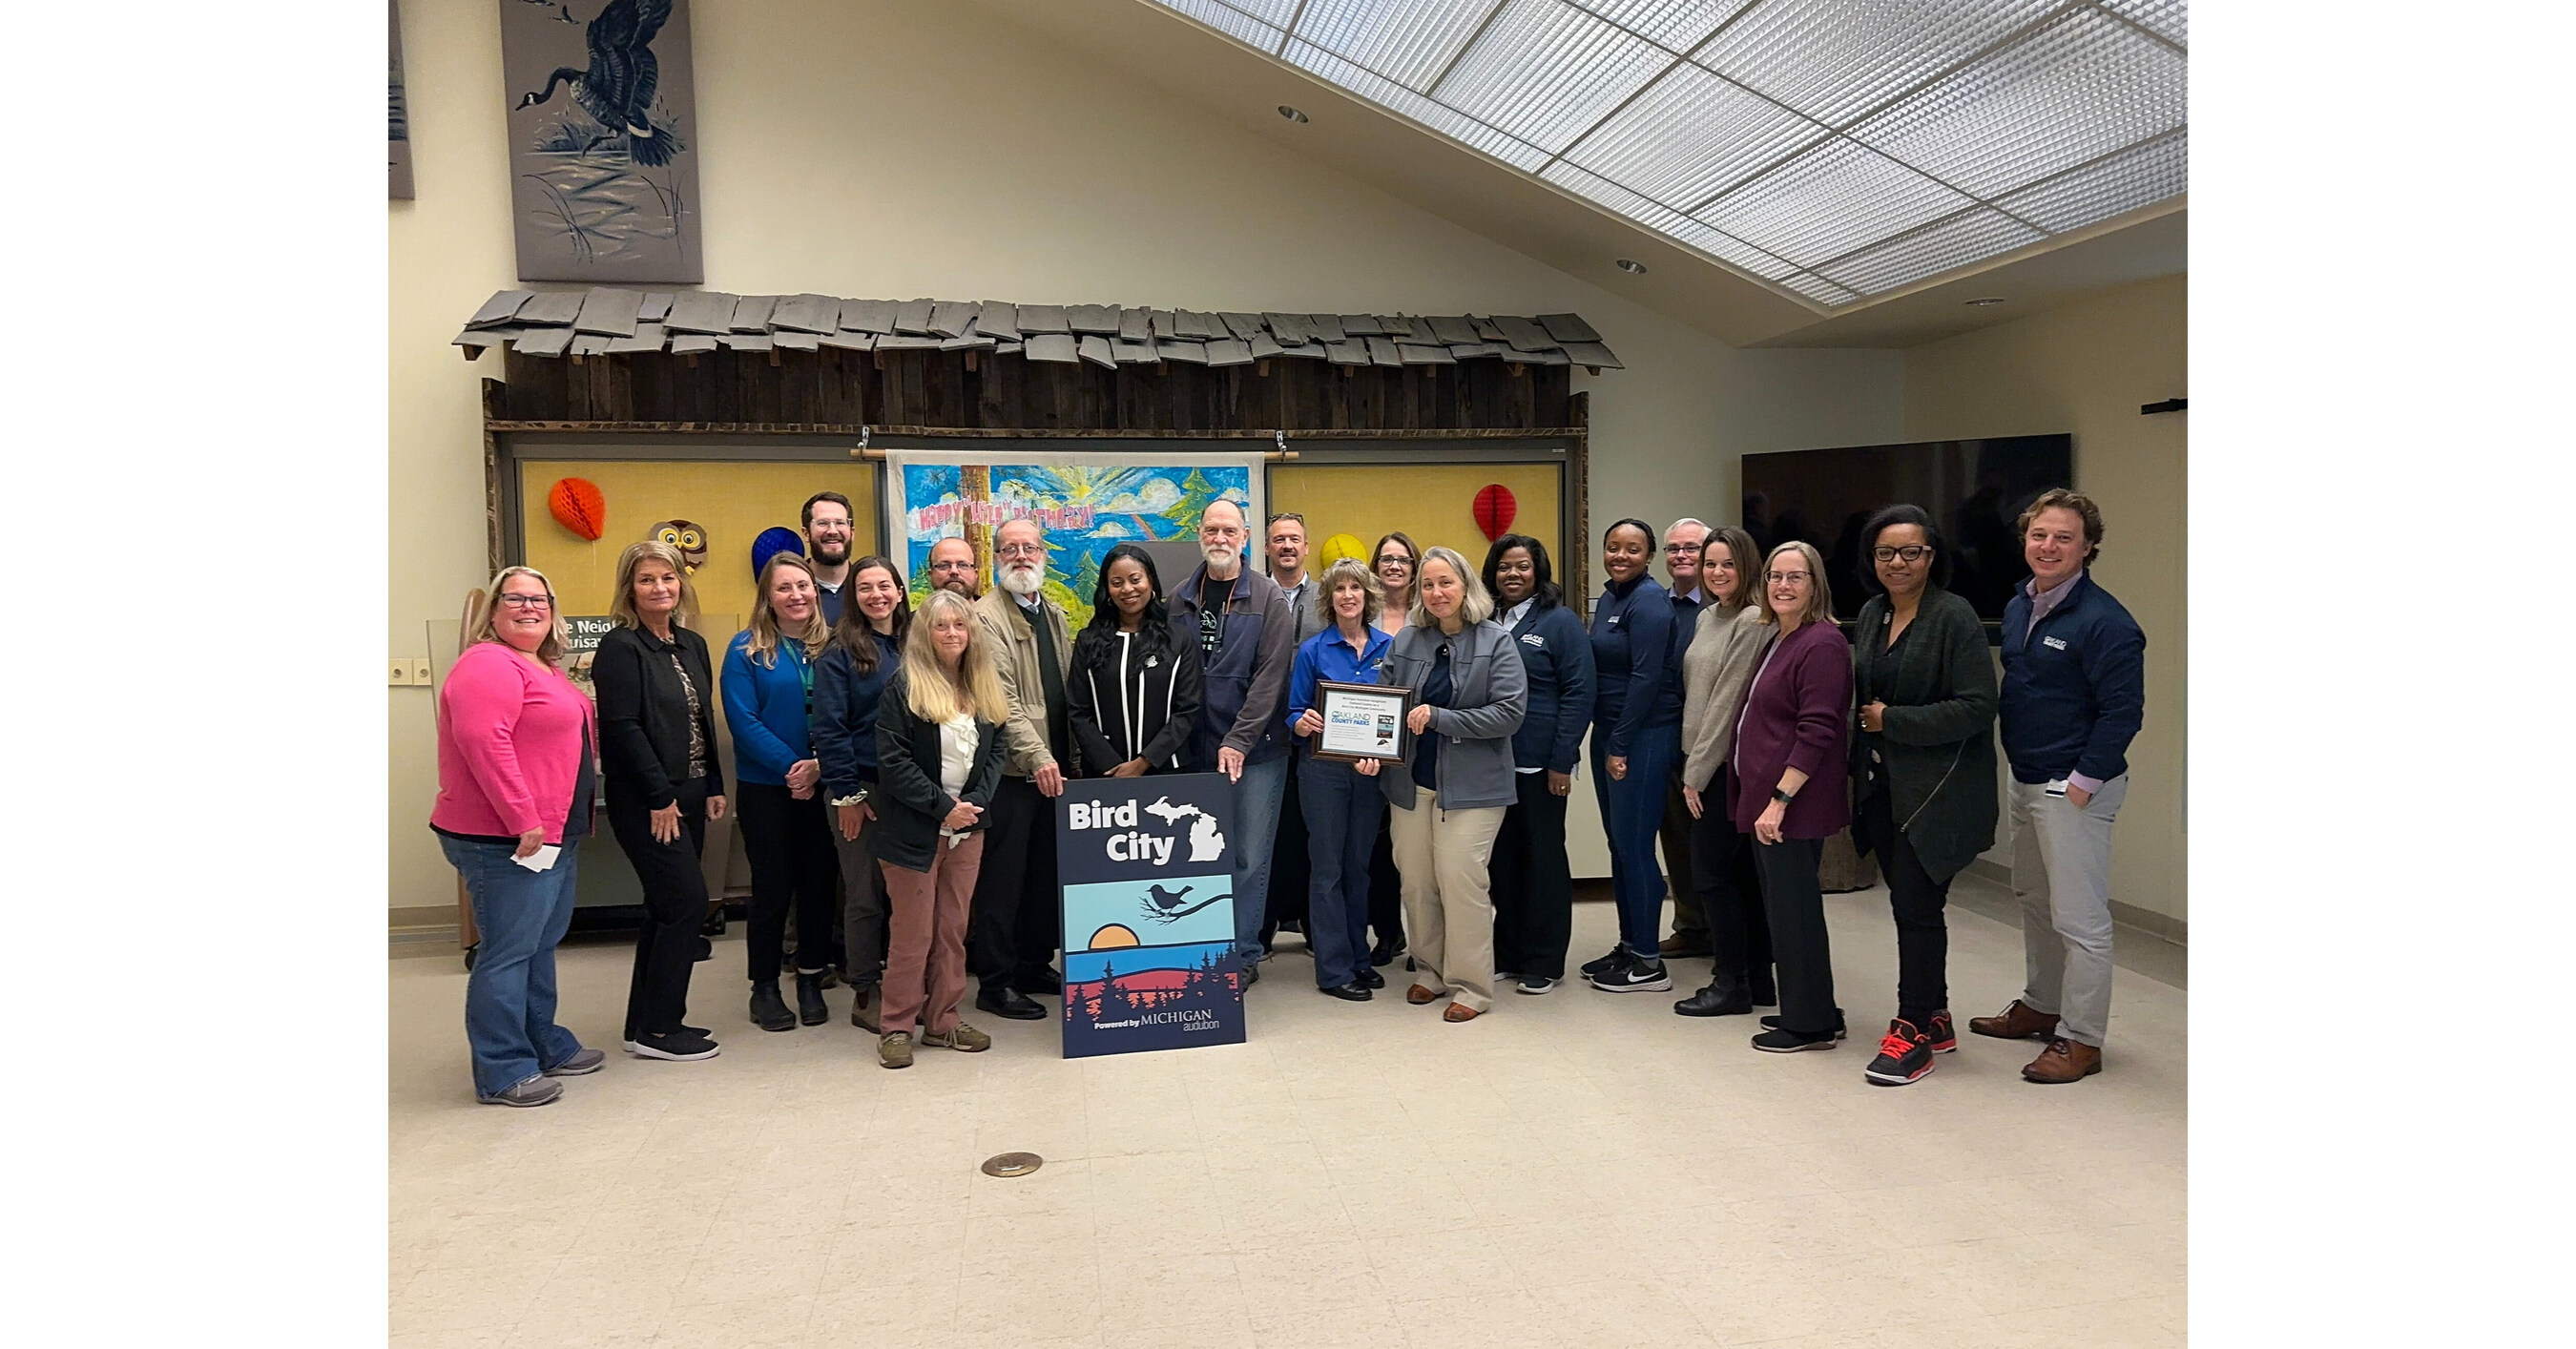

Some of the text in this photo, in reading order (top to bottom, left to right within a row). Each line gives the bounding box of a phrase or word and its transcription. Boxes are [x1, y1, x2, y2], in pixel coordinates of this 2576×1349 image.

[1331, 711, 1371, 720] OAKLAND
[1069, 799, 1138, 830] Bird
[1106, 831, 1175, 866] City
[1094, 1008, 1212, 1029] Powered by MICHIGAN
[1183, 1020, 1219, 1031] audubon
